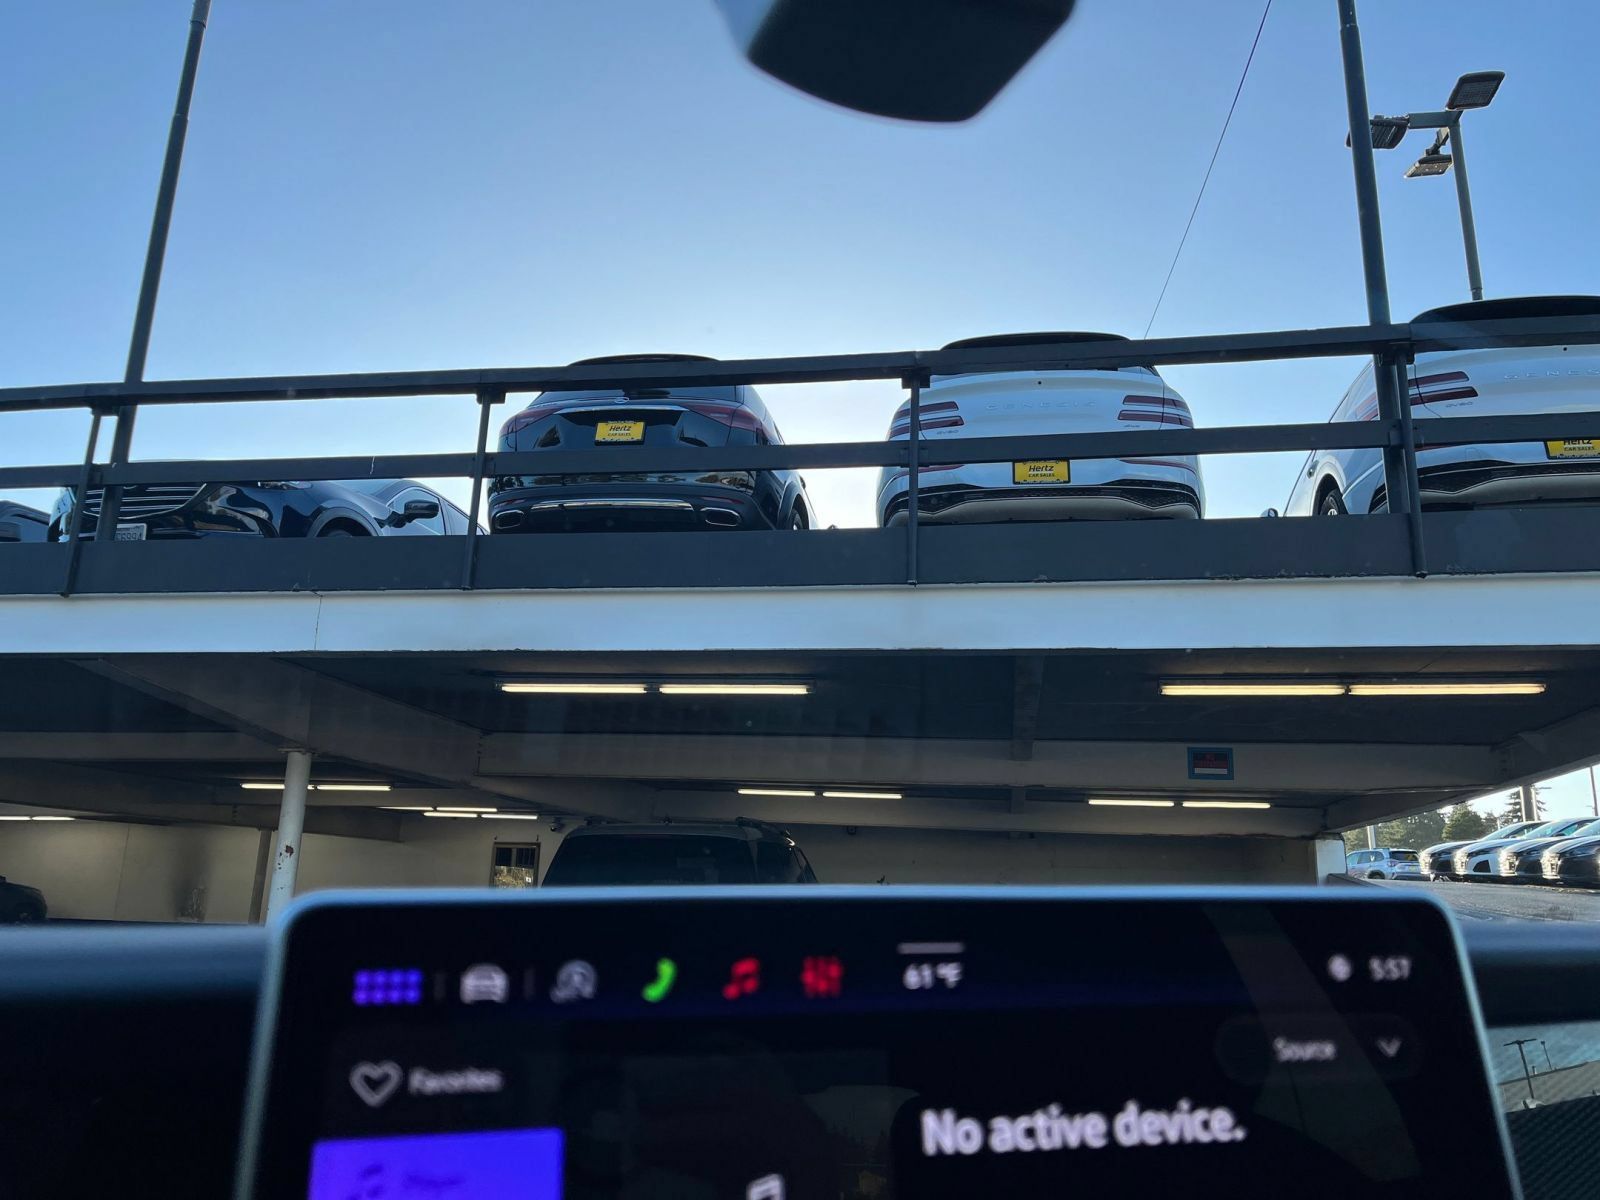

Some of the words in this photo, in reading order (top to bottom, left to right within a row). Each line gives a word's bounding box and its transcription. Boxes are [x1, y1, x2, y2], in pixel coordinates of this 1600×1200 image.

[1028, 464, 1055, 472] Hertz
[1273, 1037, 1336, 1062] Source
[408, 1066, 503, 1096] Favorites
[921, 1107, 982, 1156] No
[988, 1102, 1107, 1152] active
[1113, 1097, 1246, 1146] device.
